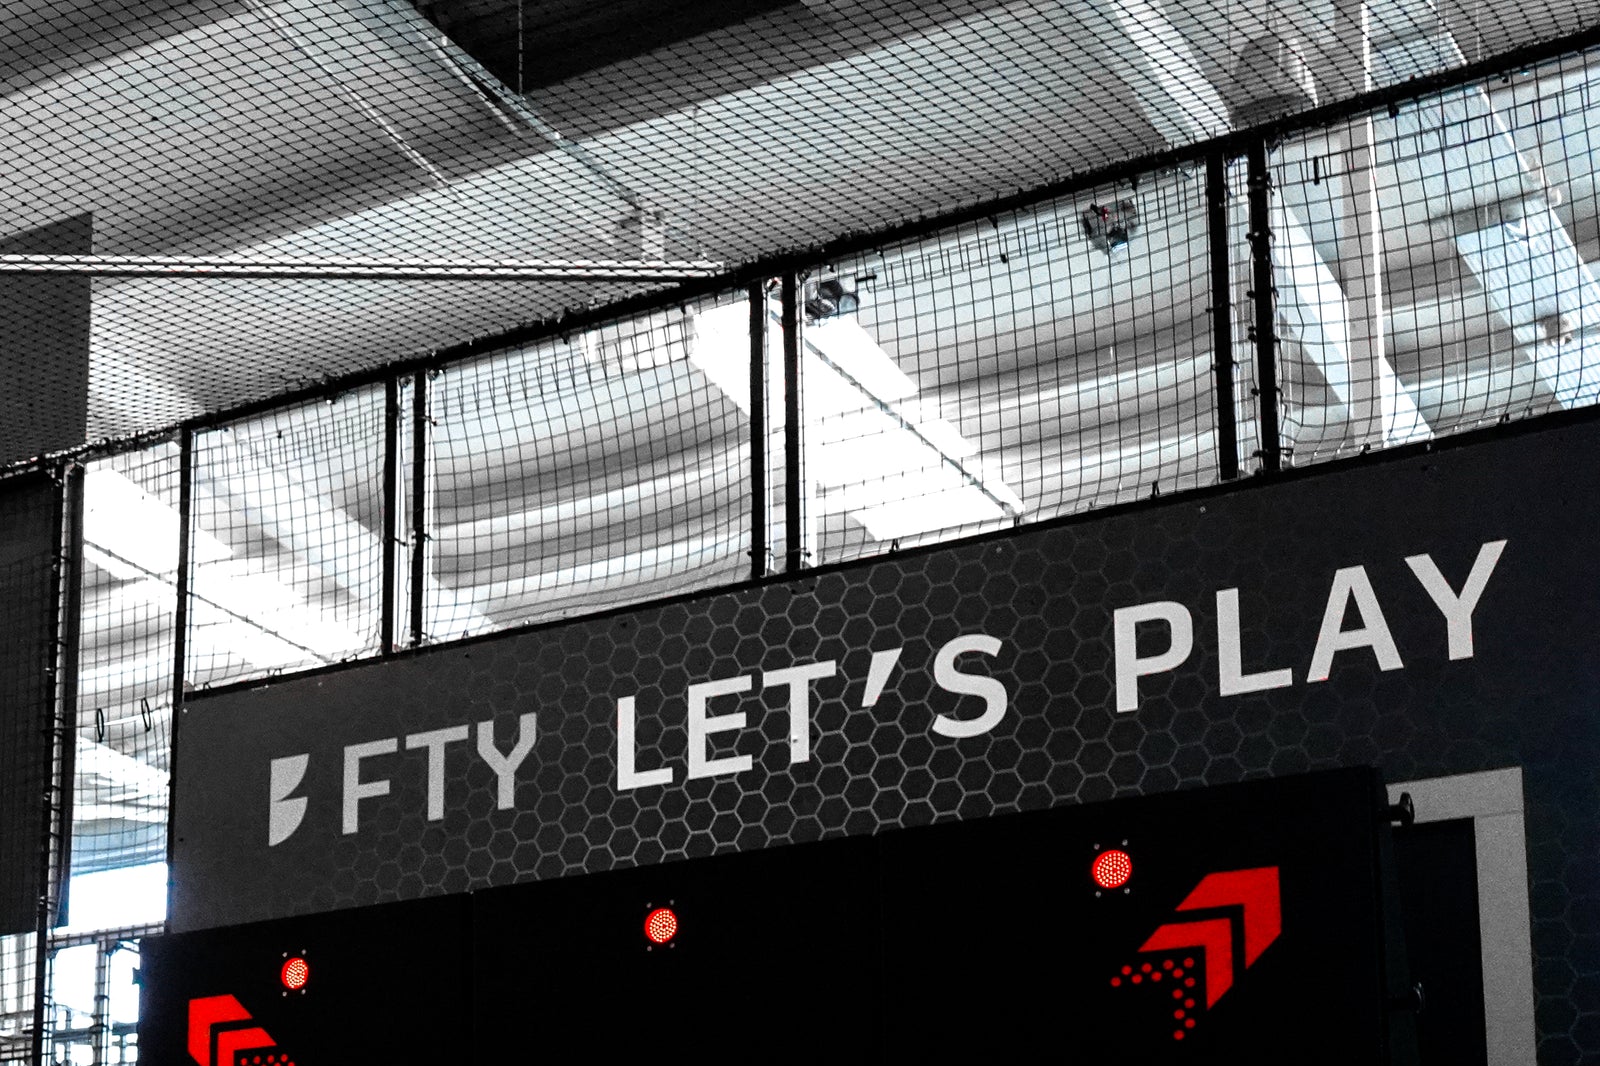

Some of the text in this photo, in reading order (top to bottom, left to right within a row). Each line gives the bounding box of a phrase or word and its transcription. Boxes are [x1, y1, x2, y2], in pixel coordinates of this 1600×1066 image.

[342, 539, 1508, 835] FTY LET'S PLAY
